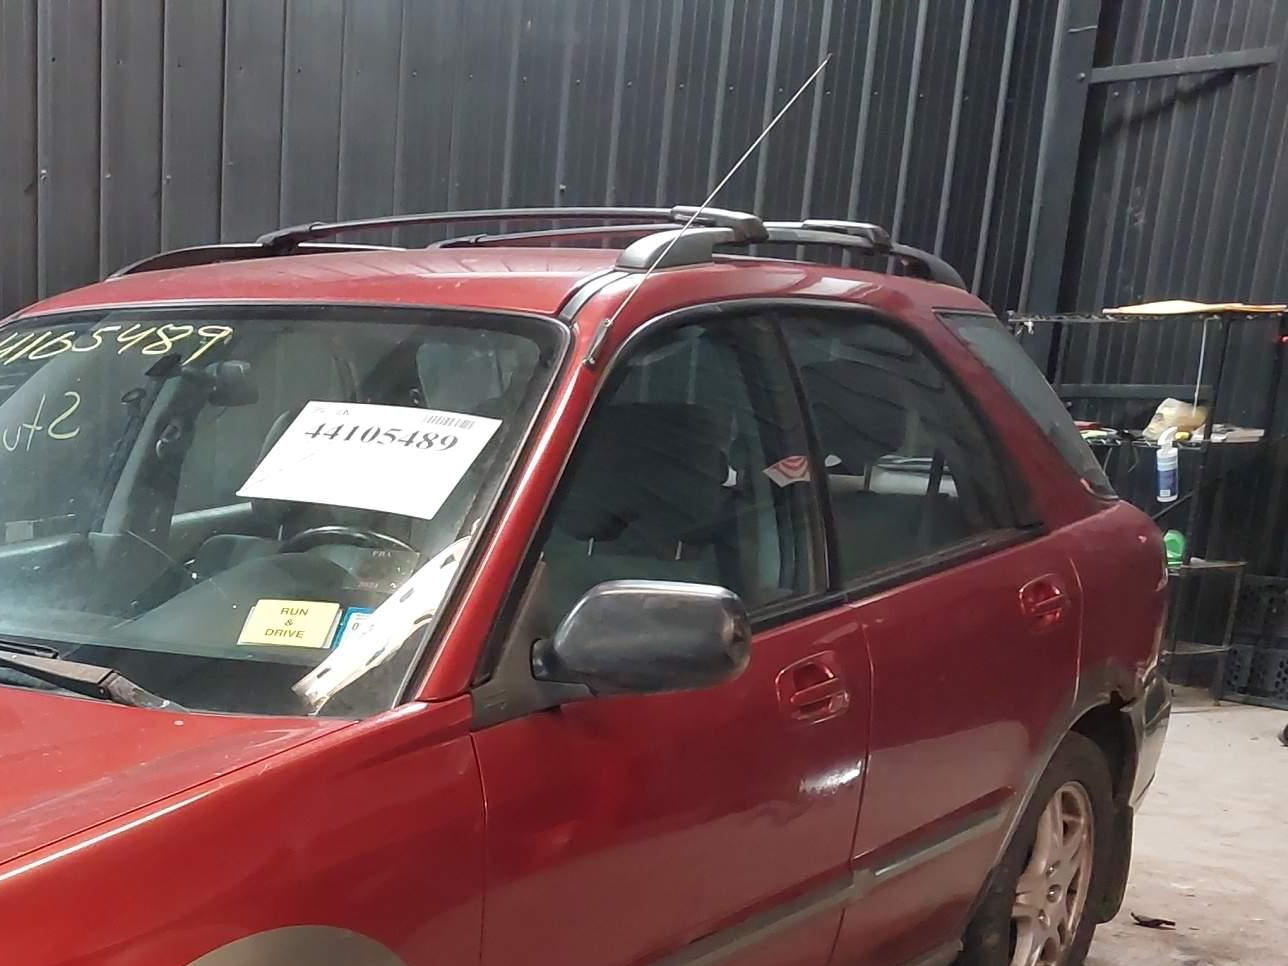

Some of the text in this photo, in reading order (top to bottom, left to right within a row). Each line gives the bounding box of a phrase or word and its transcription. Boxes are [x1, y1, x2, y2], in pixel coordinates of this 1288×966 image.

[304, 422, 460, 453] 44105489
[280, 607, 309, 617] RUN
[284, 618, 294, 627] &
[264, 629, 305, 639] DRIVE
